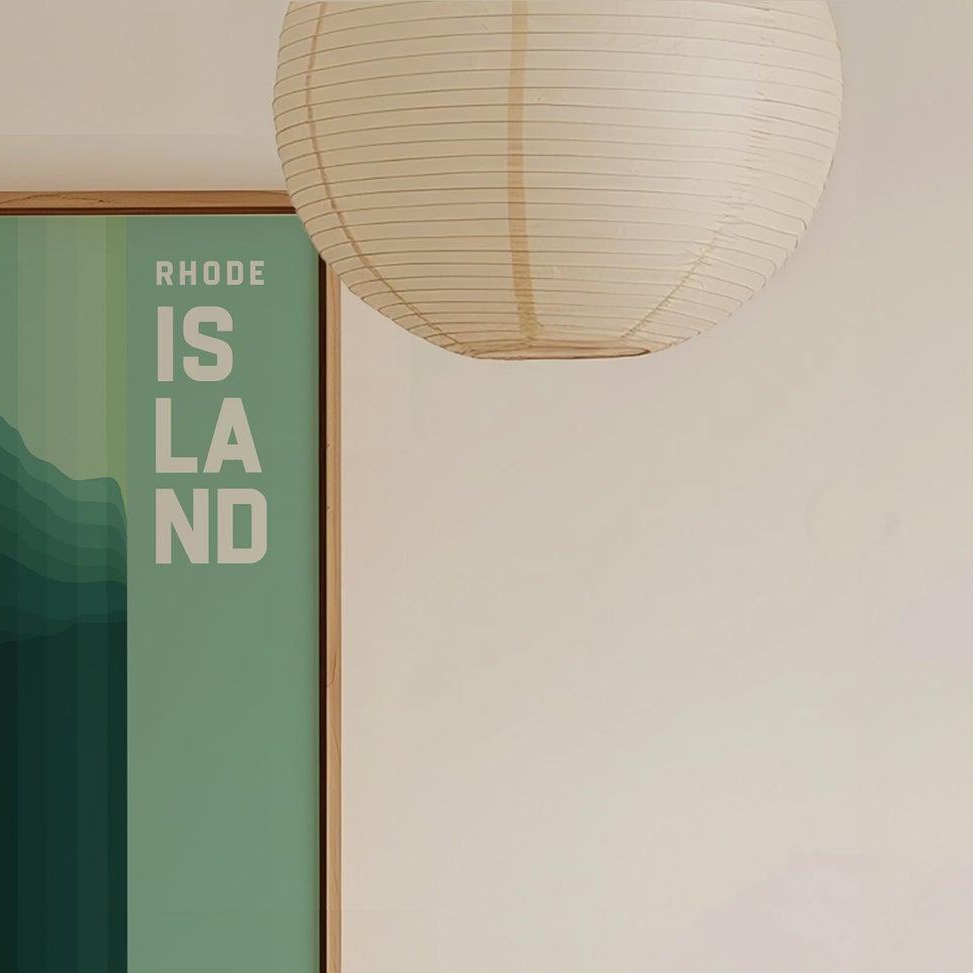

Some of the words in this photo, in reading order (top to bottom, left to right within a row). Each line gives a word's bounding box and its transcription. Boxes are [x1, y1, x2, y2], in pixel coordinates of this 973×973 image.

[156, 260, 265, 286] RHODE
[157, 306, 233, 382] IS
[155, 396, 262, 473] LA
[155, 488, 267, 564] ND
